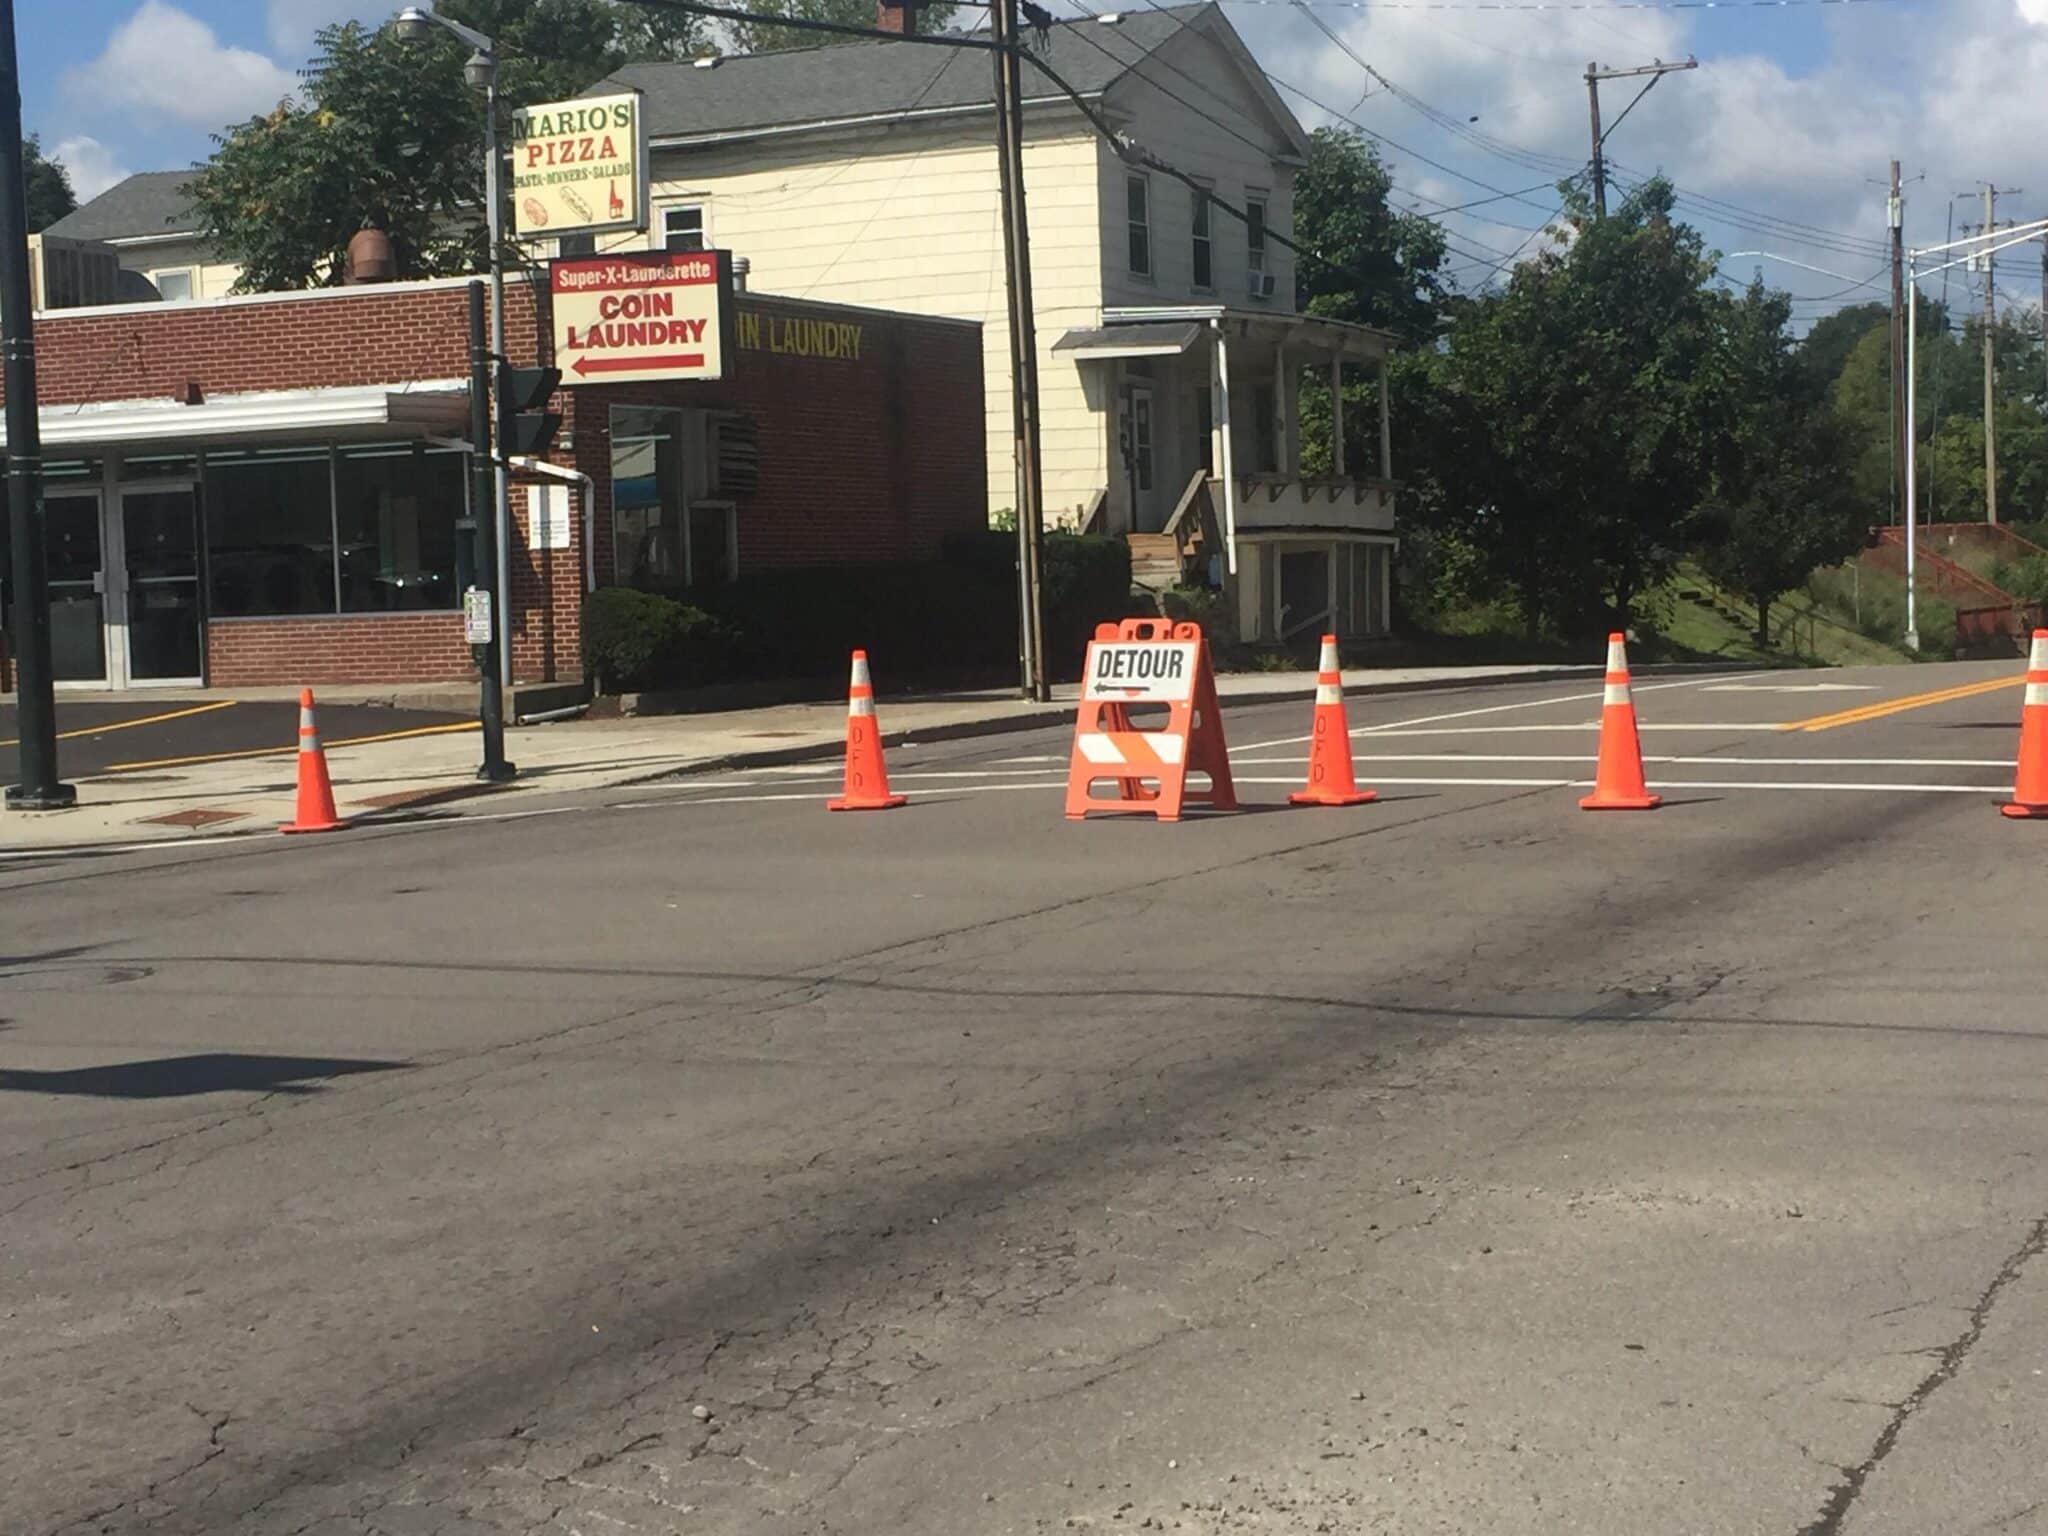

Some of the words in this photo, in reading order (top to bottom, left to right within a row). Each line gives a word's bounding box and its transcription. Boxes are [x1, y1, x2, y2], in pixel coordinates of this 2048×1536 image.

[512, 104, 629, 138] MARIO'S
[527, 136, 617, 167] PIZZA
[600, 292, 673, 319] COIN
[567, 318, 707, 349] LAUNDRY
[736, 311, 760, 350] IN
[768, 316, 861, 360] LAUNDRY
[1097, 649, 1184, 679] DETOUR
